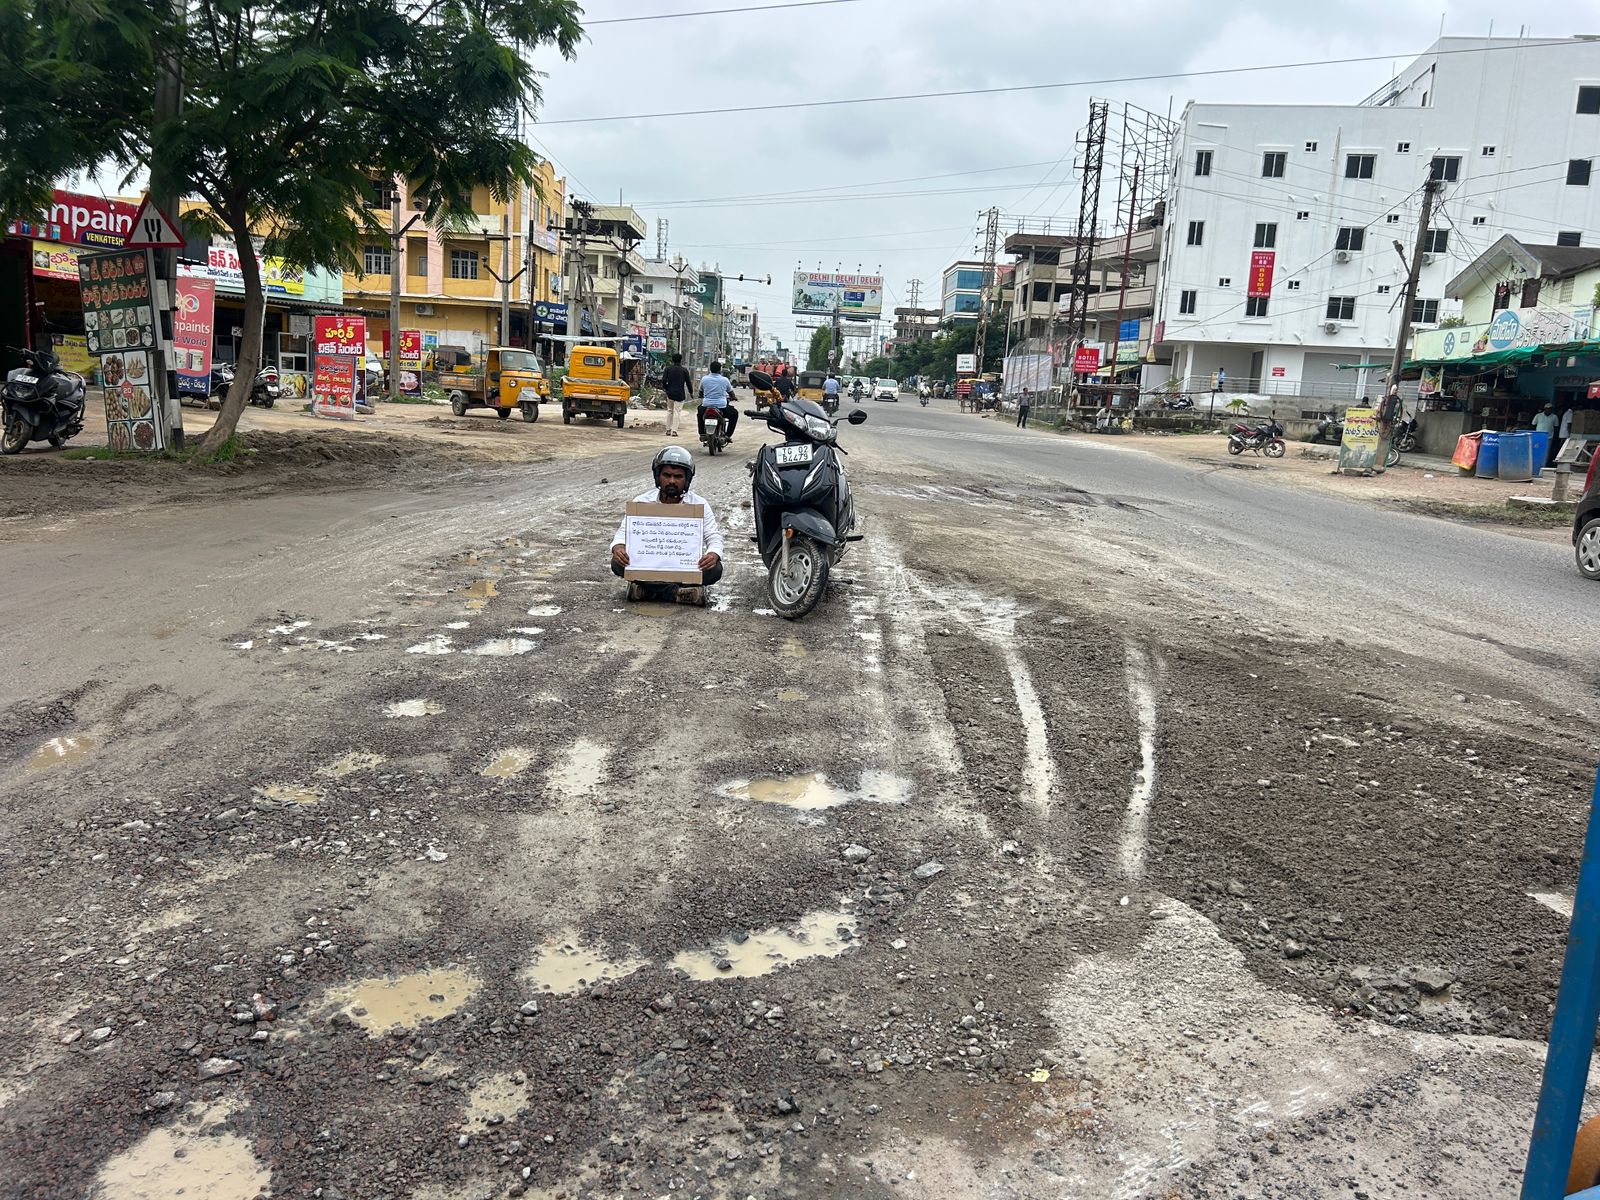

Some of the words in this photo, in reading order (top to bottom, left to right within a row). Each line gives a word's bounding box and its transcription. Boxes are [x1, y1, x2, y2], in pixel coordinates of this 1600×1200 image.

[86, 232, 125, 246] VENKATESH
[1256, 268, 1265, 292] ROOMS
[182, 336, 208, 347] World
[650, 340, 666, 349] 20%
[318, 342, 336, 354] చికెన్
[338, 342, 362, 354] సెంటర్
[798, 446, 808, 454] 02
